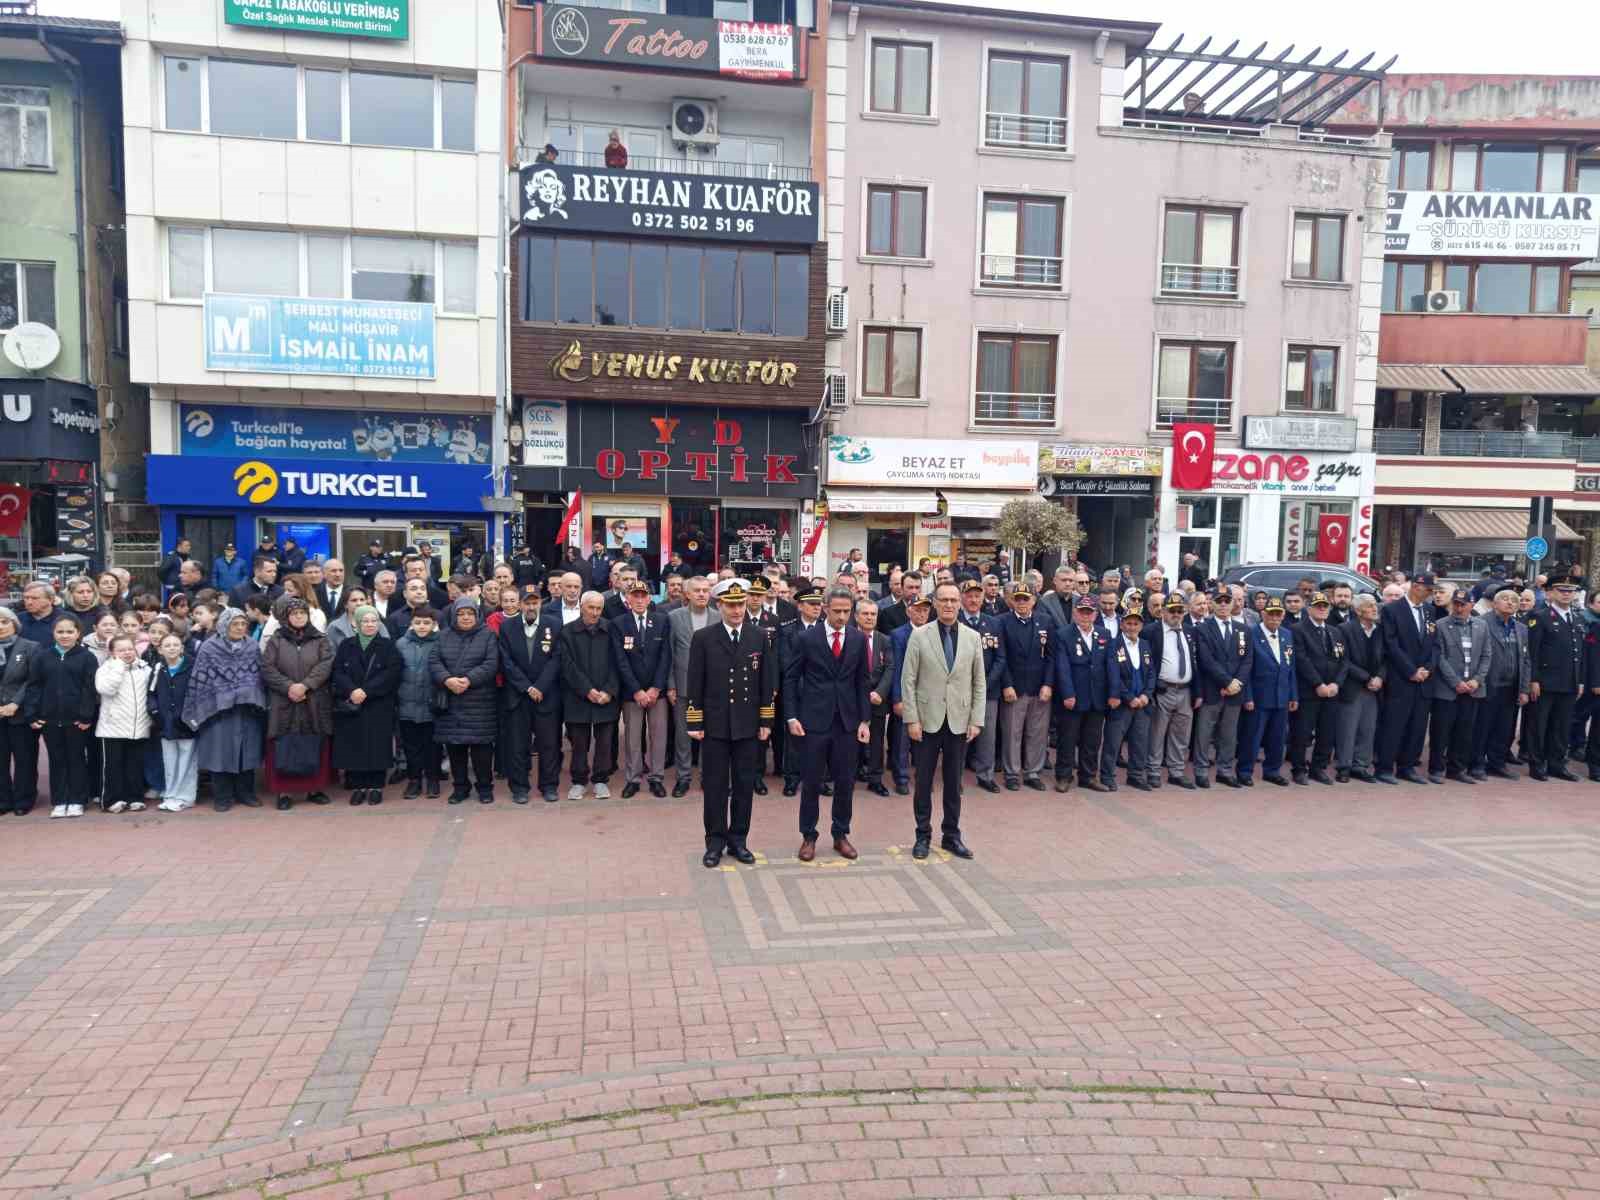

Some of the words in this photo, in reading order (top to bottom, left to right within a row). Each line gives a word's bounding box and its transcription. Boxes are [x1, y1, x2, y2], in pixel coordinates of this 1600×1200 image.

[242, 9, 264, 21] Özel
[266, 11, 295, 25] Sağlık
[297, 14, 329, 26] Meslek
[331, 17, 363, 30] Hizmet
[364, 20, 392, 32] Birimi
[343, 2, 400, 21] VERİMBAŞ
[603, 18, 709, 60] Tattoo
[723, 34, 746, 44] 0538
[748, 35, 765, 45] 628
[766, 36, 777, 45] 67
[778, 37, 789, 46] 67
[572, 174, 693, 209] REYHAN
[702, 181, 813, 216] KUAFÖR
[1422, 195, 1592, 220] AKMANLAR
[680, 214, 709, 231] 502
[715, 216, 732, 232] 51
[736, 217, 754, 233] 96
[1430, 220, 1511, 238] SÜRÜCÜ
[1515, 223, 1584, 240] KURSU
[279, 334, 362, 361] İSMAİL
[368, 337, 429, 364] İNAM
[591, 350, 682, 381] VENÜS
[688, 354, 798, 388] KUAFÖR
[231, 420, 304, 436] Turkcell'le
[235, 435, 288, 450] bağlan
[290, 438, 347, 451] hayata!
[595, 447, 799, 484] OPTİK
[902, 456, 946, 469] BEYAZ
[950, 457, 965, 470] ET
[1213, 453, 1310, 482] zane
[1315, 460, 1362, 482] çağrı
[281, 471, 428, 499] TURKCELL
[886, 470, 925, 481] ÇAYCUMA
